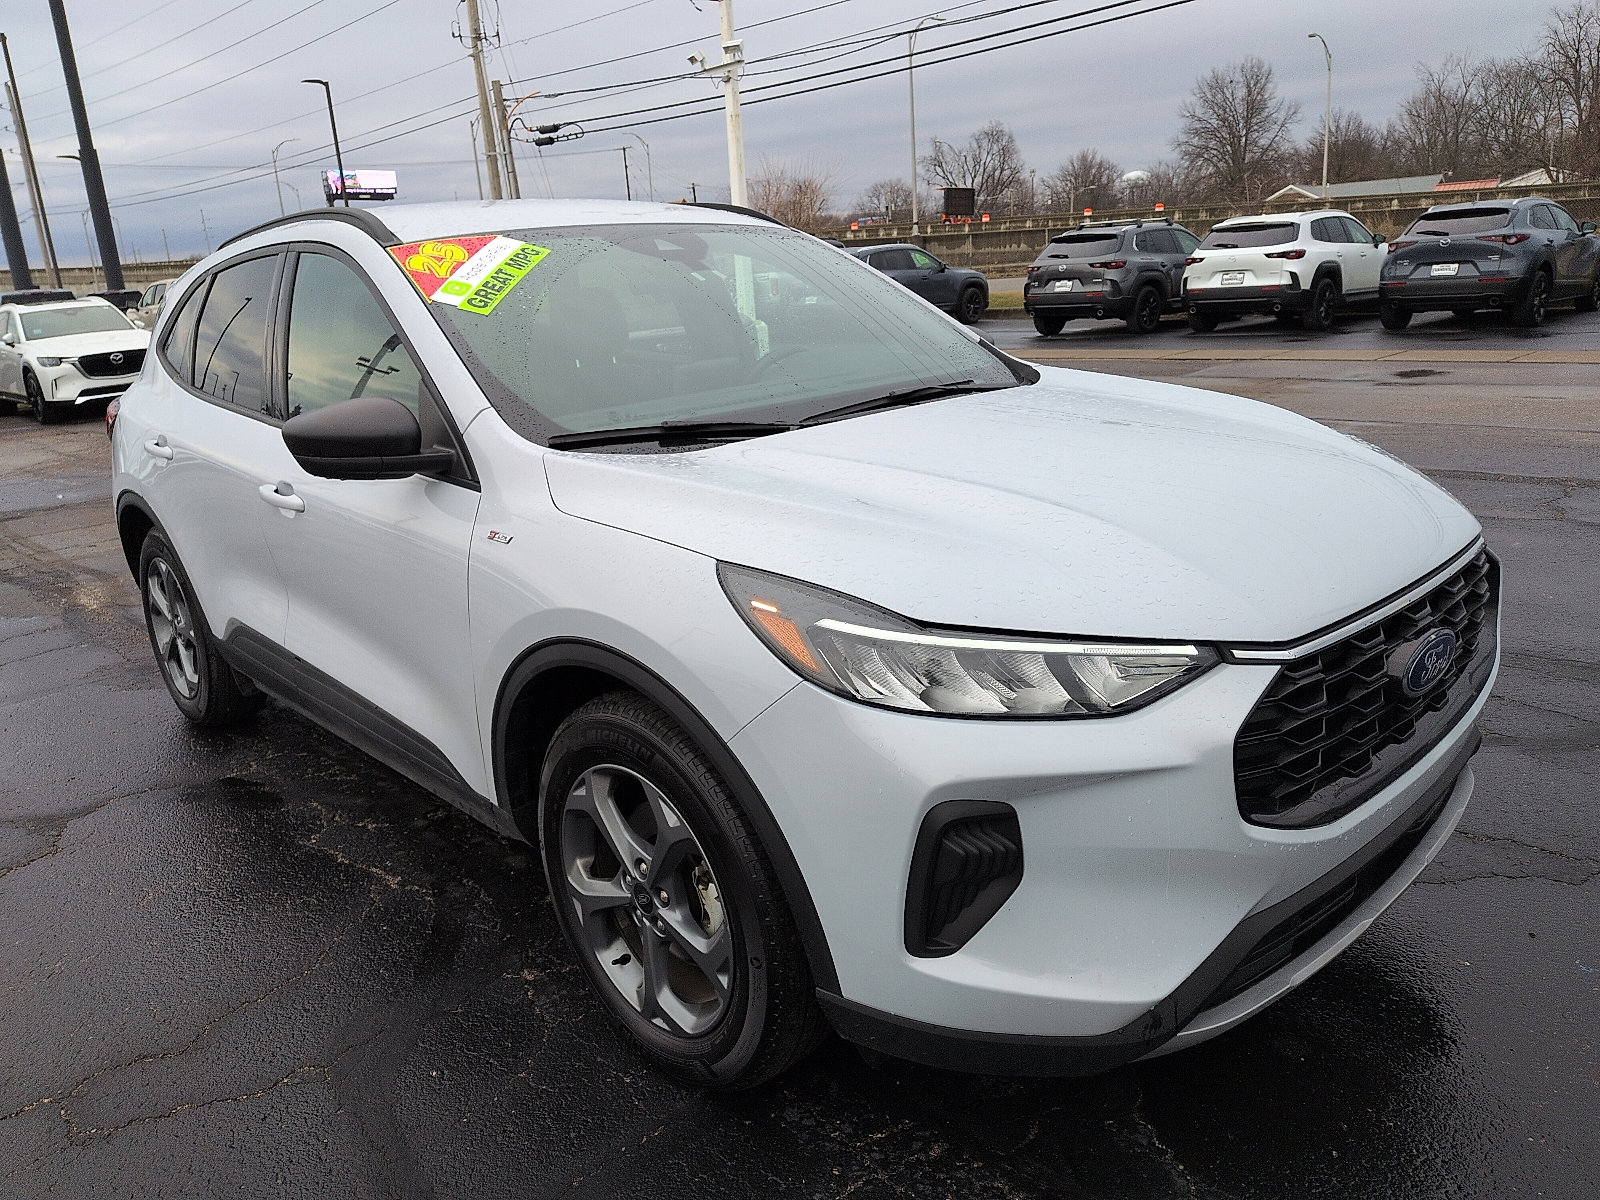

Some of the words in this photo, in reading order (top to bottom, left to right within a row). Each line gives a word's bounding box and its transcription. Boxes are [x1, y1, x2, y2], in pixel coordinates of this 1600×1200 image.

[405, 242, 469, 278] 25
[466, 268, 516, 309] GREAT
[506, 246, 543, 271] MPG
[1421, 643, 1451, 683] Ford
[586, 728, 655, 762] MICHELIN
